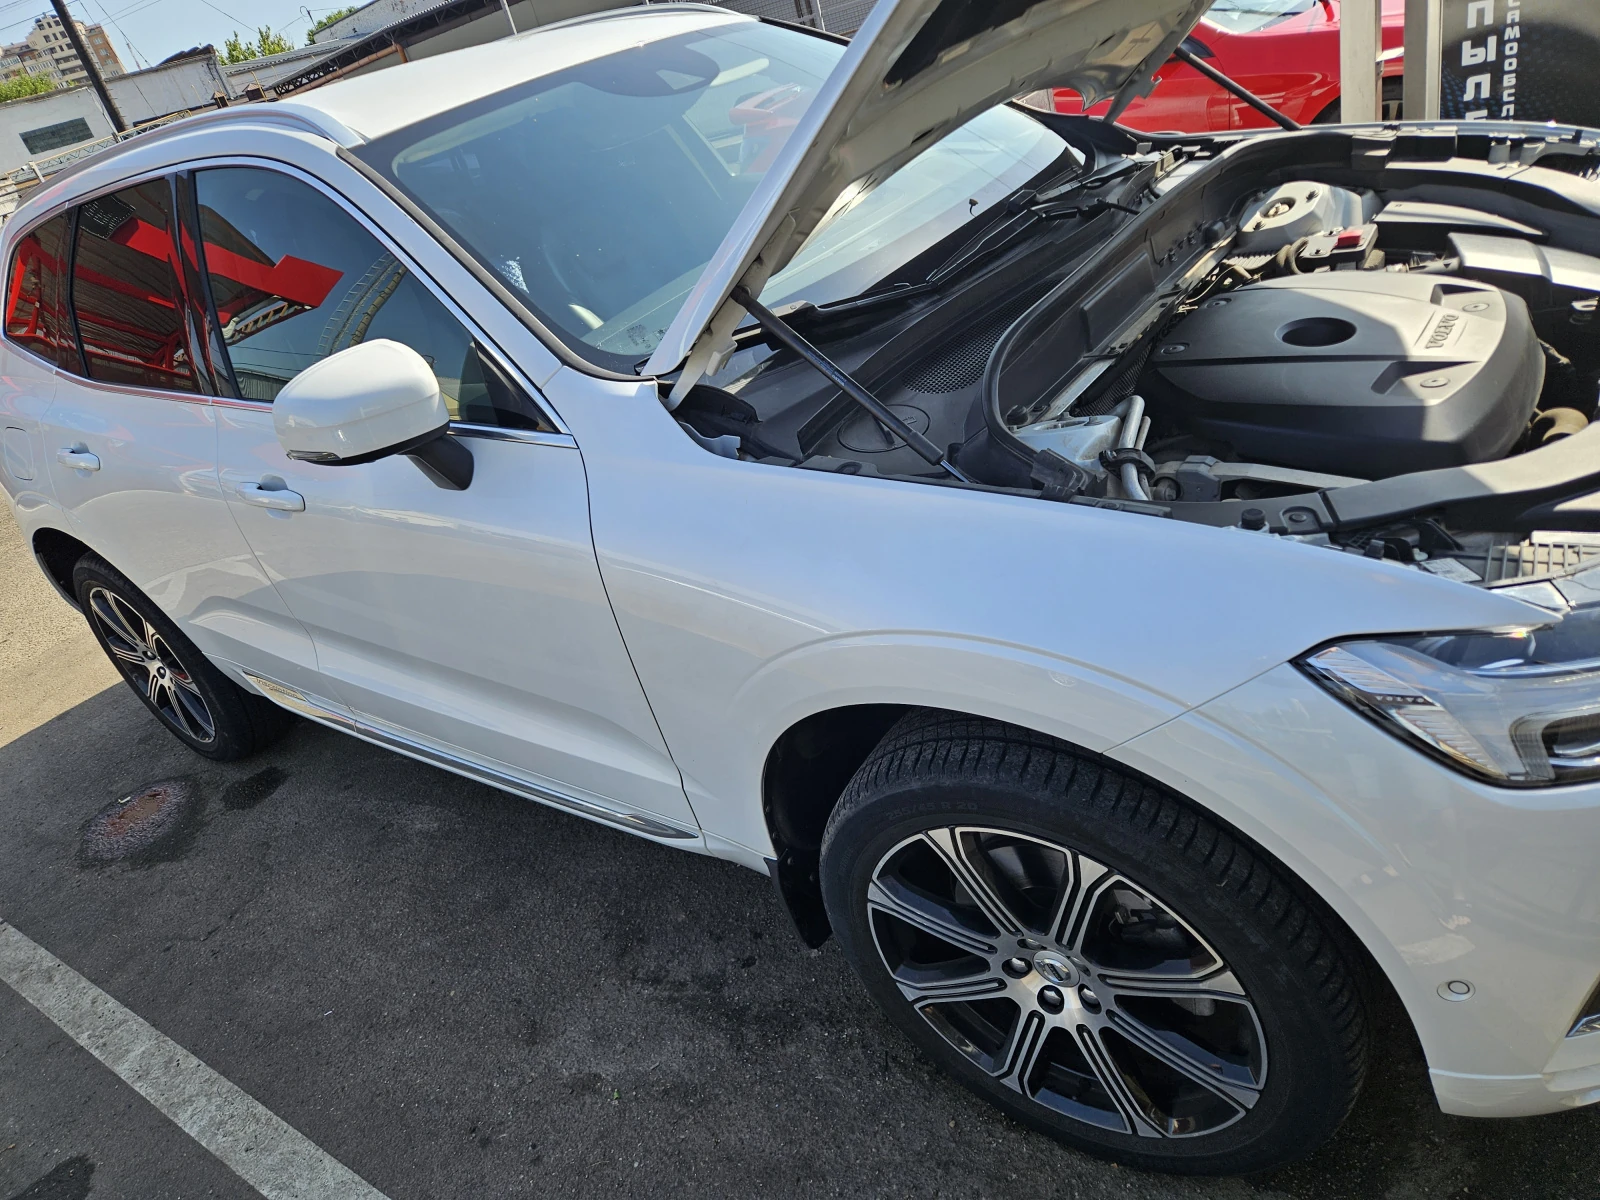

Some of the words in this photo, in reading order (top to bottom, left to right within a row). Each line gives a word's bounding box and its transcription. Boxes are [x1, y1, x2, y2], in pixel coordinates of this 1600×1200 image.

[1501, 0, 1520, 120] АМООБСЛ
[1425, 313, 1459, 349] VOLVO
[1374, 695, 1425, 703] VOLVO
